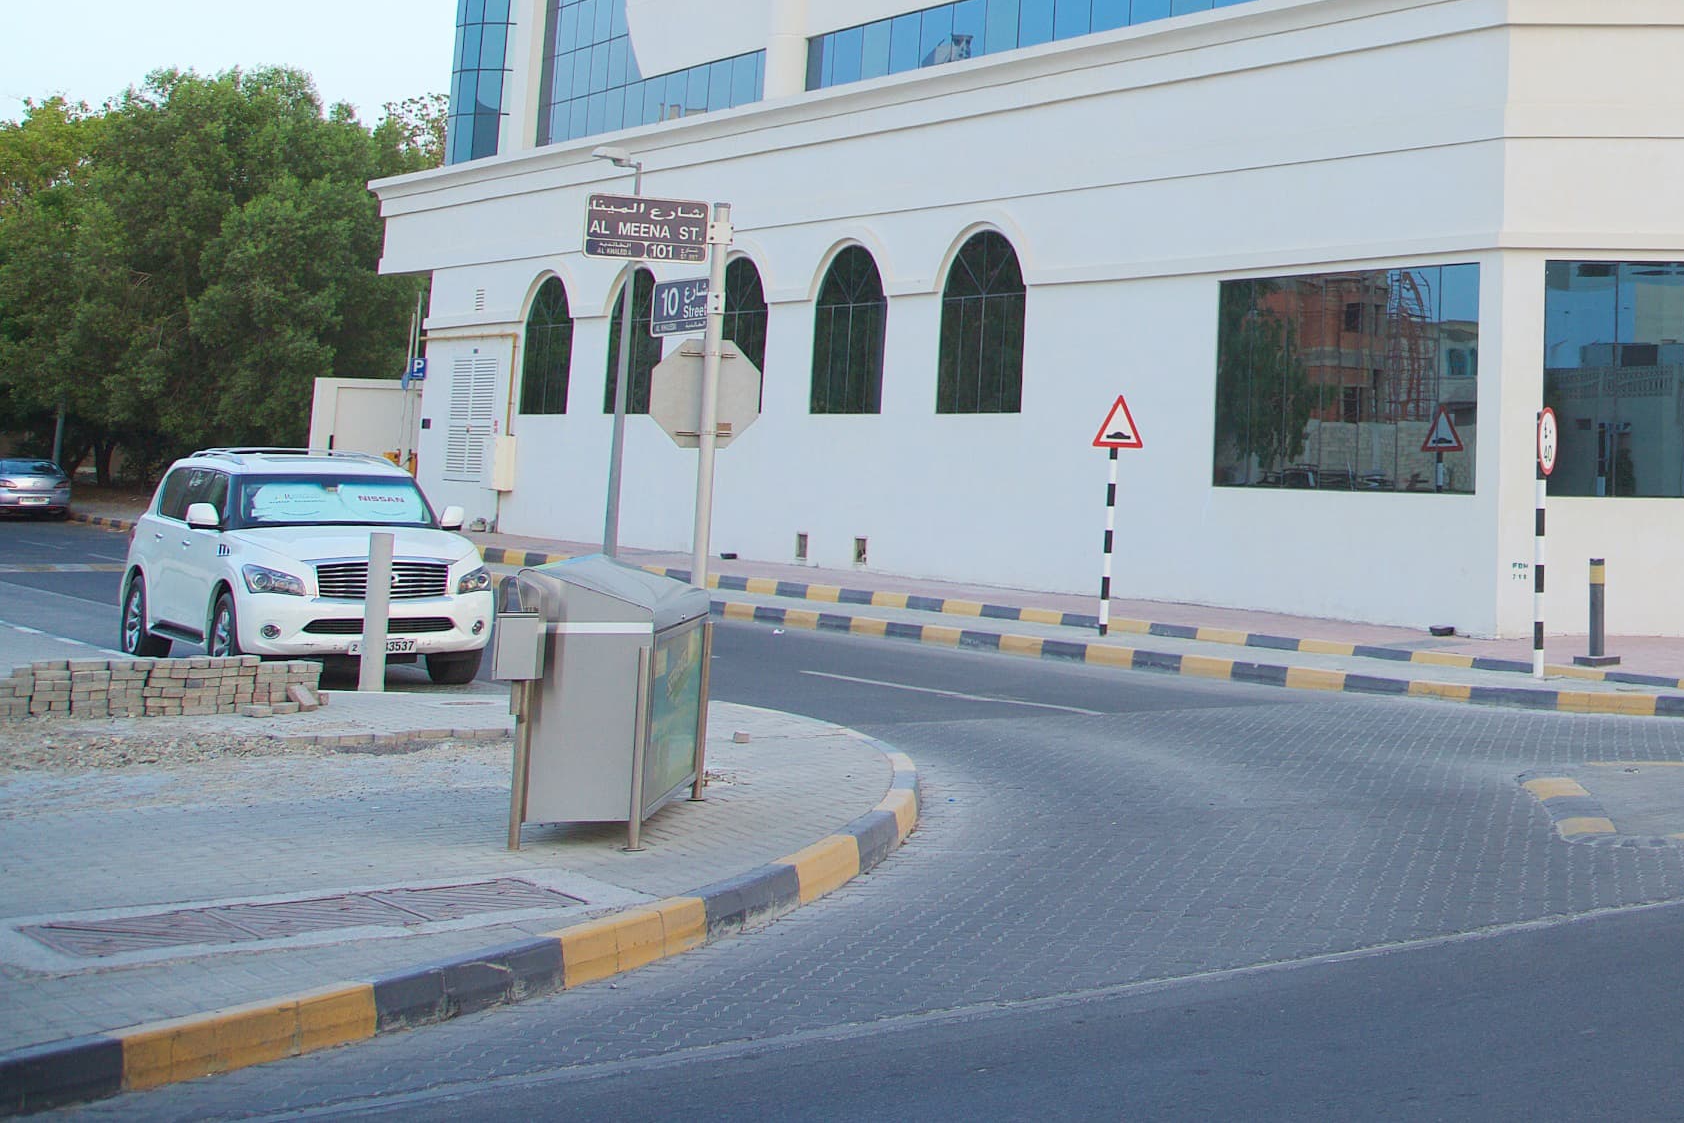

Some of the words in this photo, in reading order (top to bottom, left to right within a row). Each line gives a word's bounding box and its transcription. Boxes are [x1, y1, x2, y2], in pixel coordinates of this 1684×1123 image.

[589, 199, 645, 214] الميناء
[650, 206, 705, 220] شارع
[589, 220, 610, 234] AL
[618, 222, 670, 239] MEENA
[679, 227, 703, 241] ST.
[651, 244, 673, 258] 101
[684, 282, 708, 304] شارع
[661, 287, 679, 317] 10
[683, 303, 707, 319] Street
[413, 359, 424, 372] P
[1544, 445, 1552, 462] 40
[358, 495, 405, 503] NISSAN
[386, 641, 414, 652] 3537
